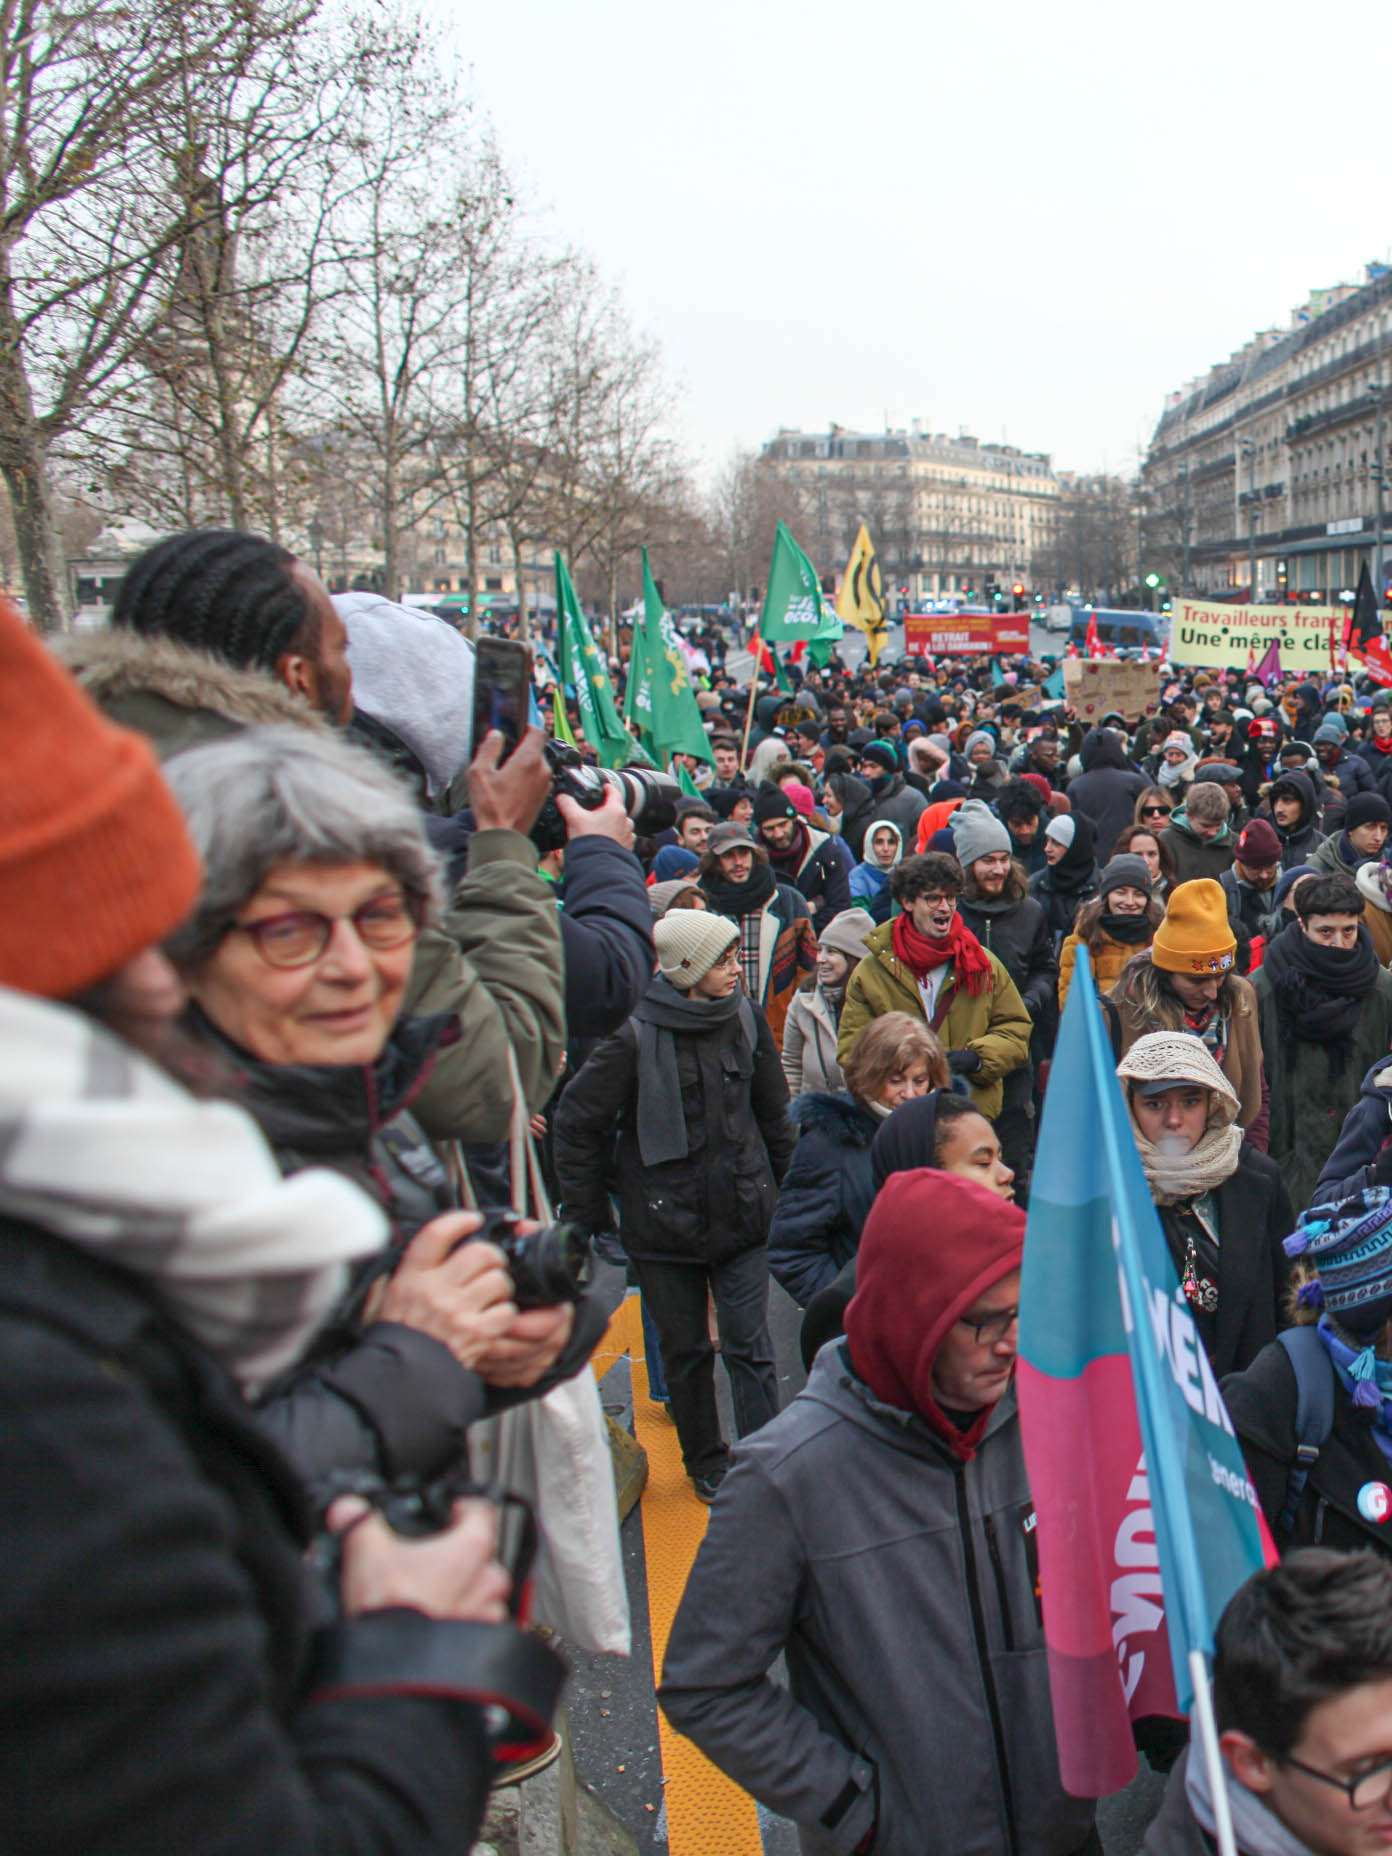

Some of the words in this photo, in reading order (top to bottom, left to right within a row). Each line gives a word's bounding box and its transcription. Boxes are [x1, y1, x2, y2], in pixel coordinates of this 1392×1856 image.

[1183, 605, 1288, 627] Travailleurs
[1181, 627, 1222, 646] Une
[1229, 632, 1295, 650] même
